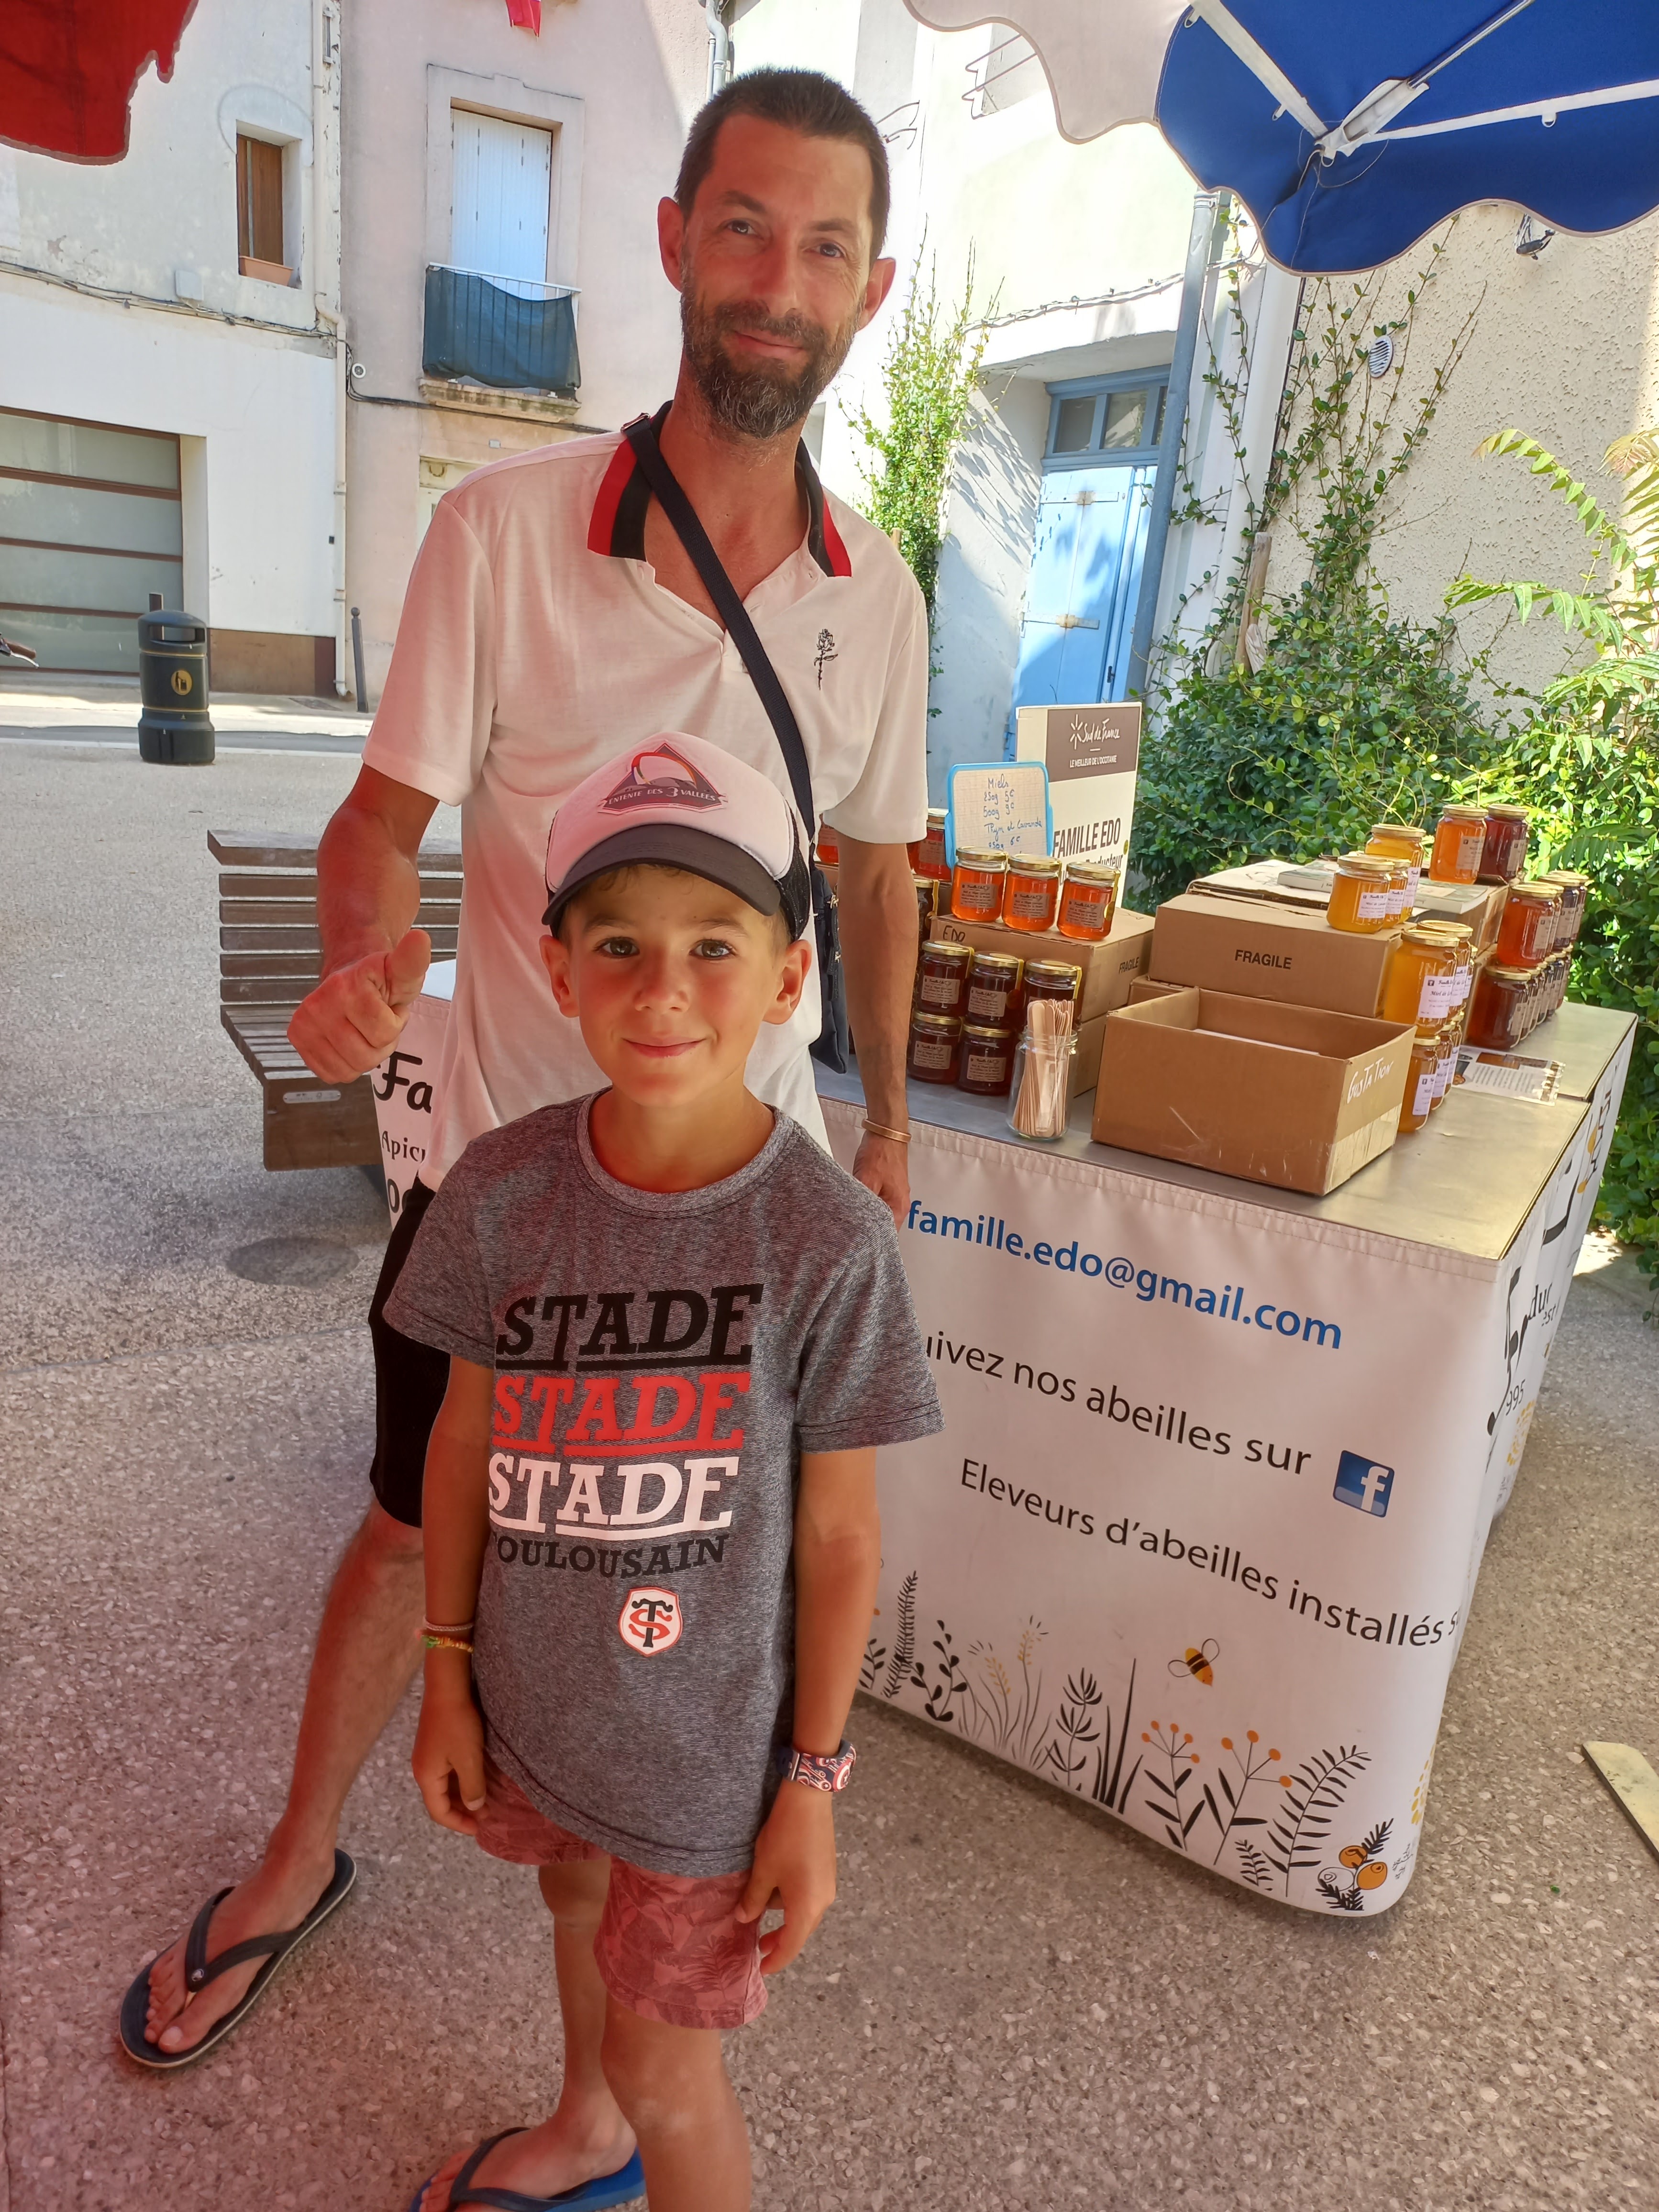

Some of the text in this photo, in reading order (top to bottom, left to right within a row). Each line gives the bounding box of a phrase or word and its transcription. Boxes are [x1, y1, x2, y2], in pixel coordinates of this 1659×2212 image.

[1082, 718, 1120, 743] Sud de France
[1070, 760, 1074, 768] LE
[1075, 758, 1092, 767] MEILLEUR
[1092, 757, 1097, 765] DE
[609, 791, 642, 805] ENTENTE
[666, 787, 678, 797] 3
[988, 774, 1009, 789] Miels
[984, 806, 1000, 820] 500g
[1052, 818, 1121, 858] FAMILLE EDO
[943, 925, 965, 942] EDO
[1118, 957, 1139, 974] FRAGILE
[1235, 949, 1293, 970] FRAGILE
[908, 1200, 1341, 1349] famille.edo@gmail.com
[496, 1284, 763, 1371] STADE
[492, 1372, 750, 1456] STADE
[1014, 1360, 1077, 1402] nos
[1086, 1384, 1231, 1457] abeilles
[1245, 1439, 1312, 1475] sur
[489, 1452, 739, 1540] STADE
[493, 1532, 729, 1579] OULOUSAIN
[961, 1458, 1095, 1536] Eleveurs
[1289, 1581, 1443, 1647] installés
